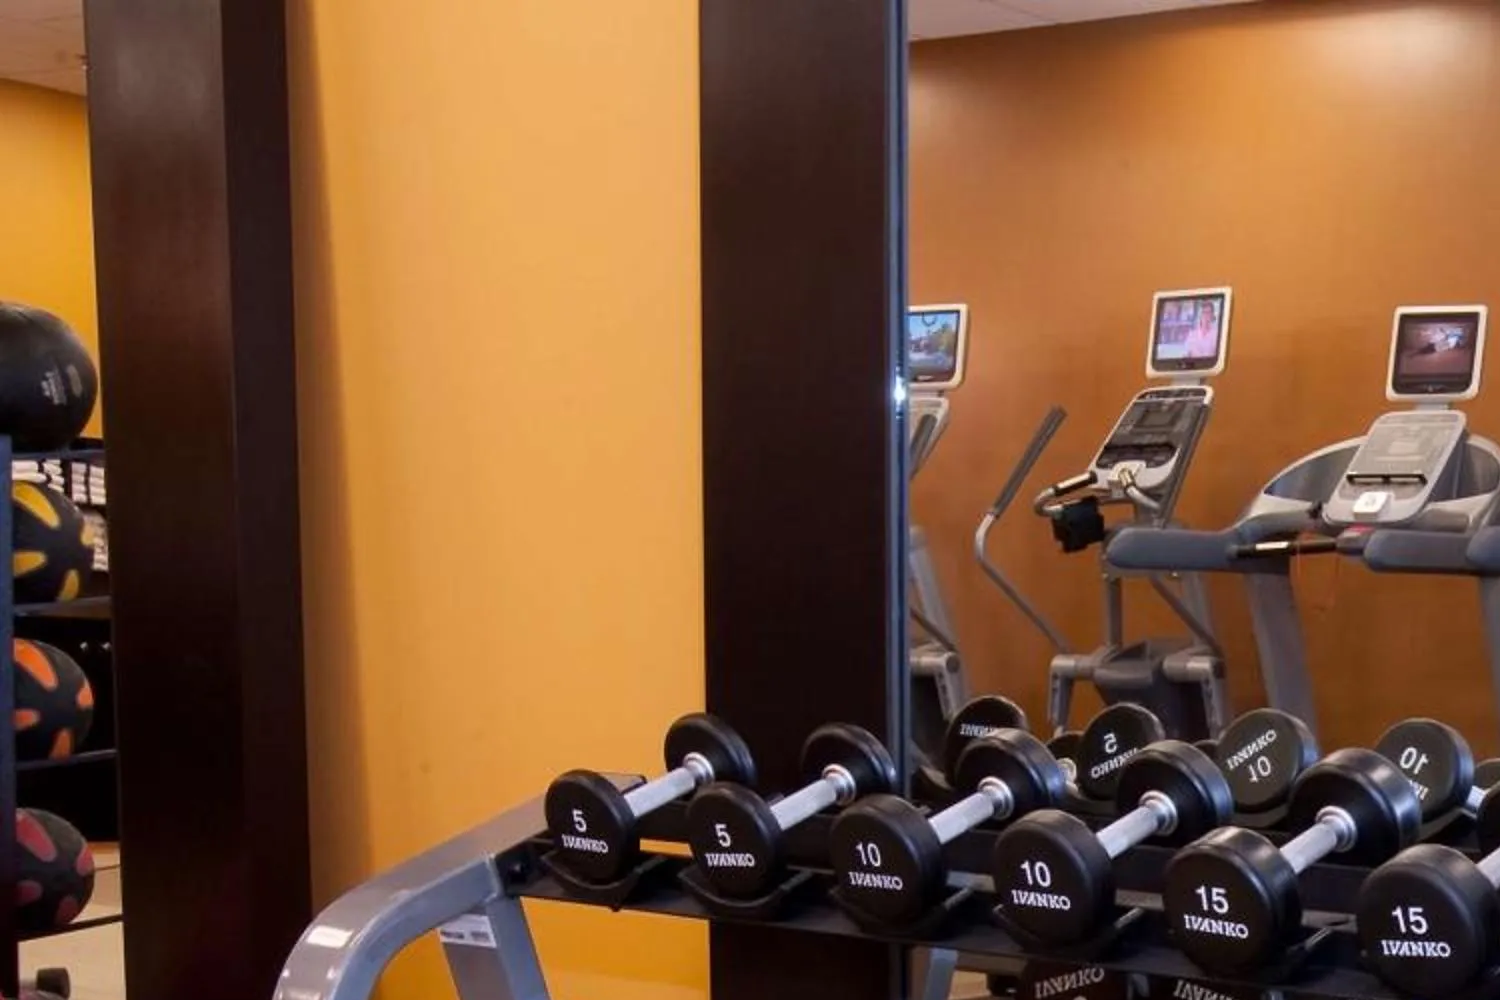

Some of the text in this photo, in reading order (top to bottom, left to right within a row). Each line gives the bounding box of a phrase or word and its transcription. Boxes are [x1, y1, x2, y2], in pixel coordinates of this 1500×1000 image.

[573, 809, 587, 833] 5
[561, 834, 609, 853] IVANKO
[715, 823, 732, 848] 5
[705, 853, 755, 868] IVANKO
[856, 842, 882, 867] 10
[848, 871, 903, 891] IVANKO
[1020, 860, 1052, 888] 10
[1011, 889, 1071, 911] IVANKO
[1195, 885, 1230, 914] 15
[1183, 914, 1250, 939] IVANKO
[1391, 906, 1429, 935] 15
[1381, 939, 1451, 958] IVANKO
